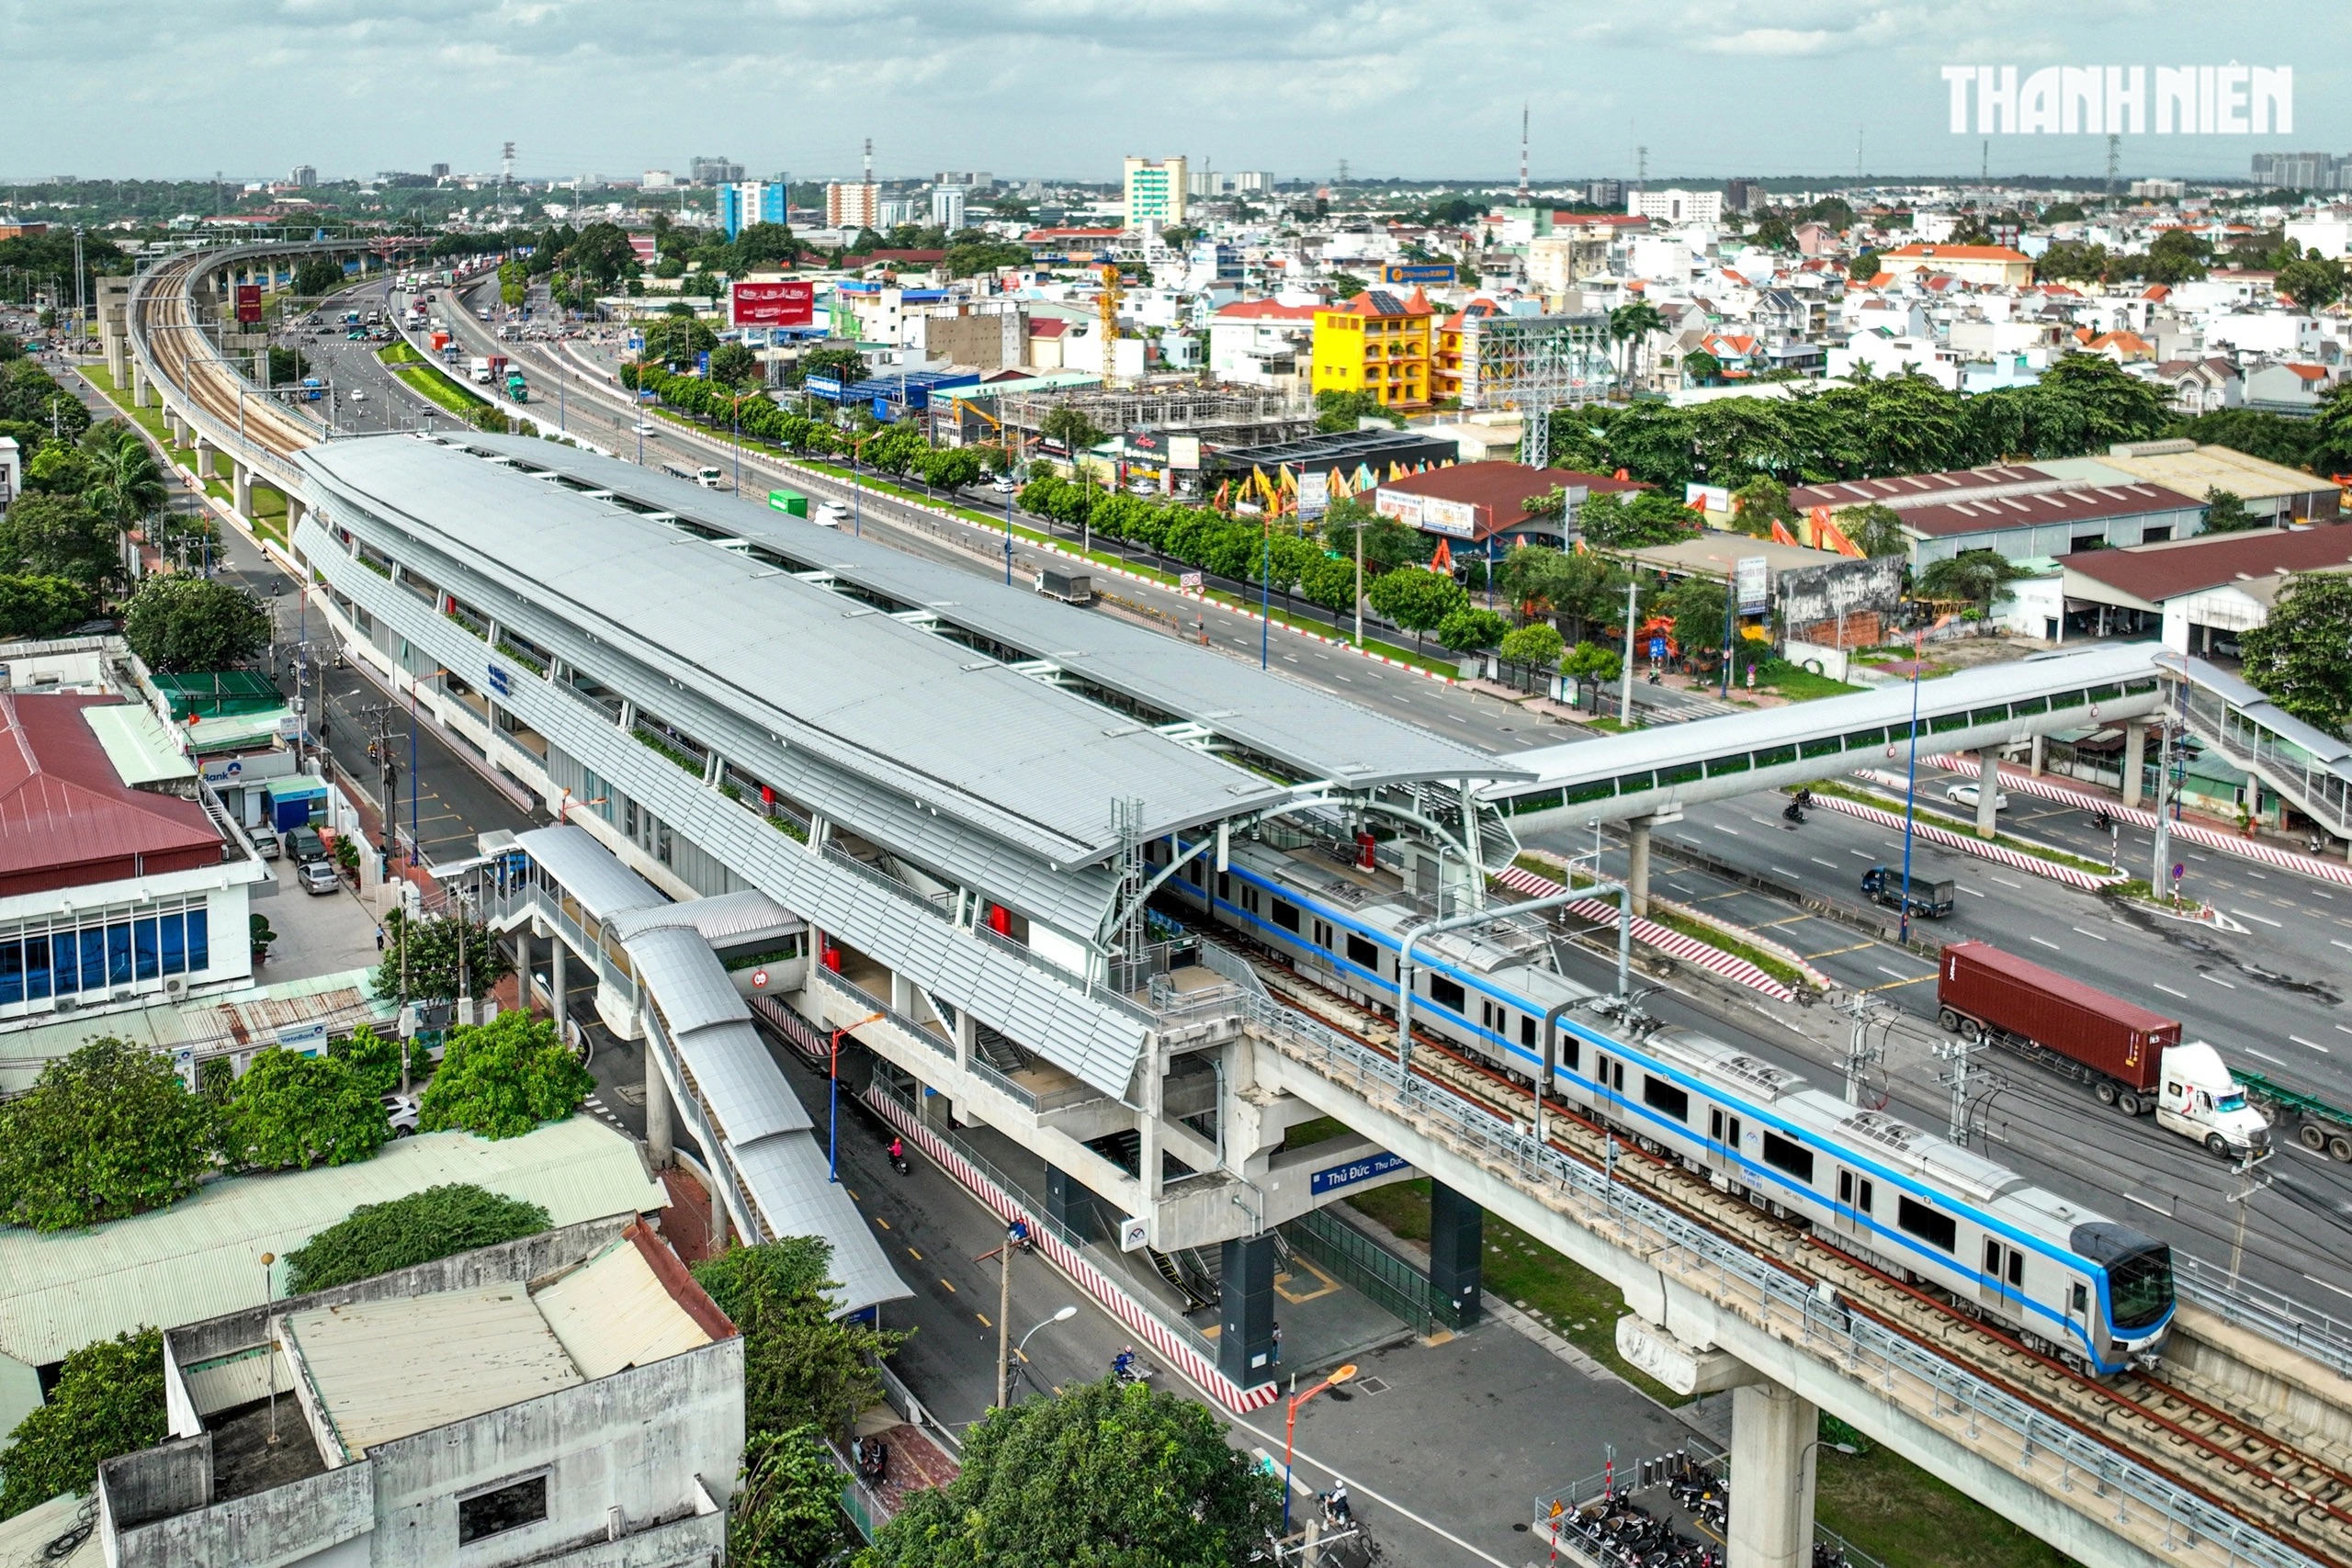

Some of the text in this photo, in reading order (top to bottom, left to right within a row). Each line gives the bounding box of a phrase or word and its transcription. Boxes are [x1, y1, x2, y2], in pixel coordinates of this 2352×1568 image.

[280, 1032, 315, 1043] VietinBank
[1327, 1168, 1347, 1186] Thủ
[1349, 1164, 1370, 1180] Đức
[1374, 1161, 1389, 1171] Thu
